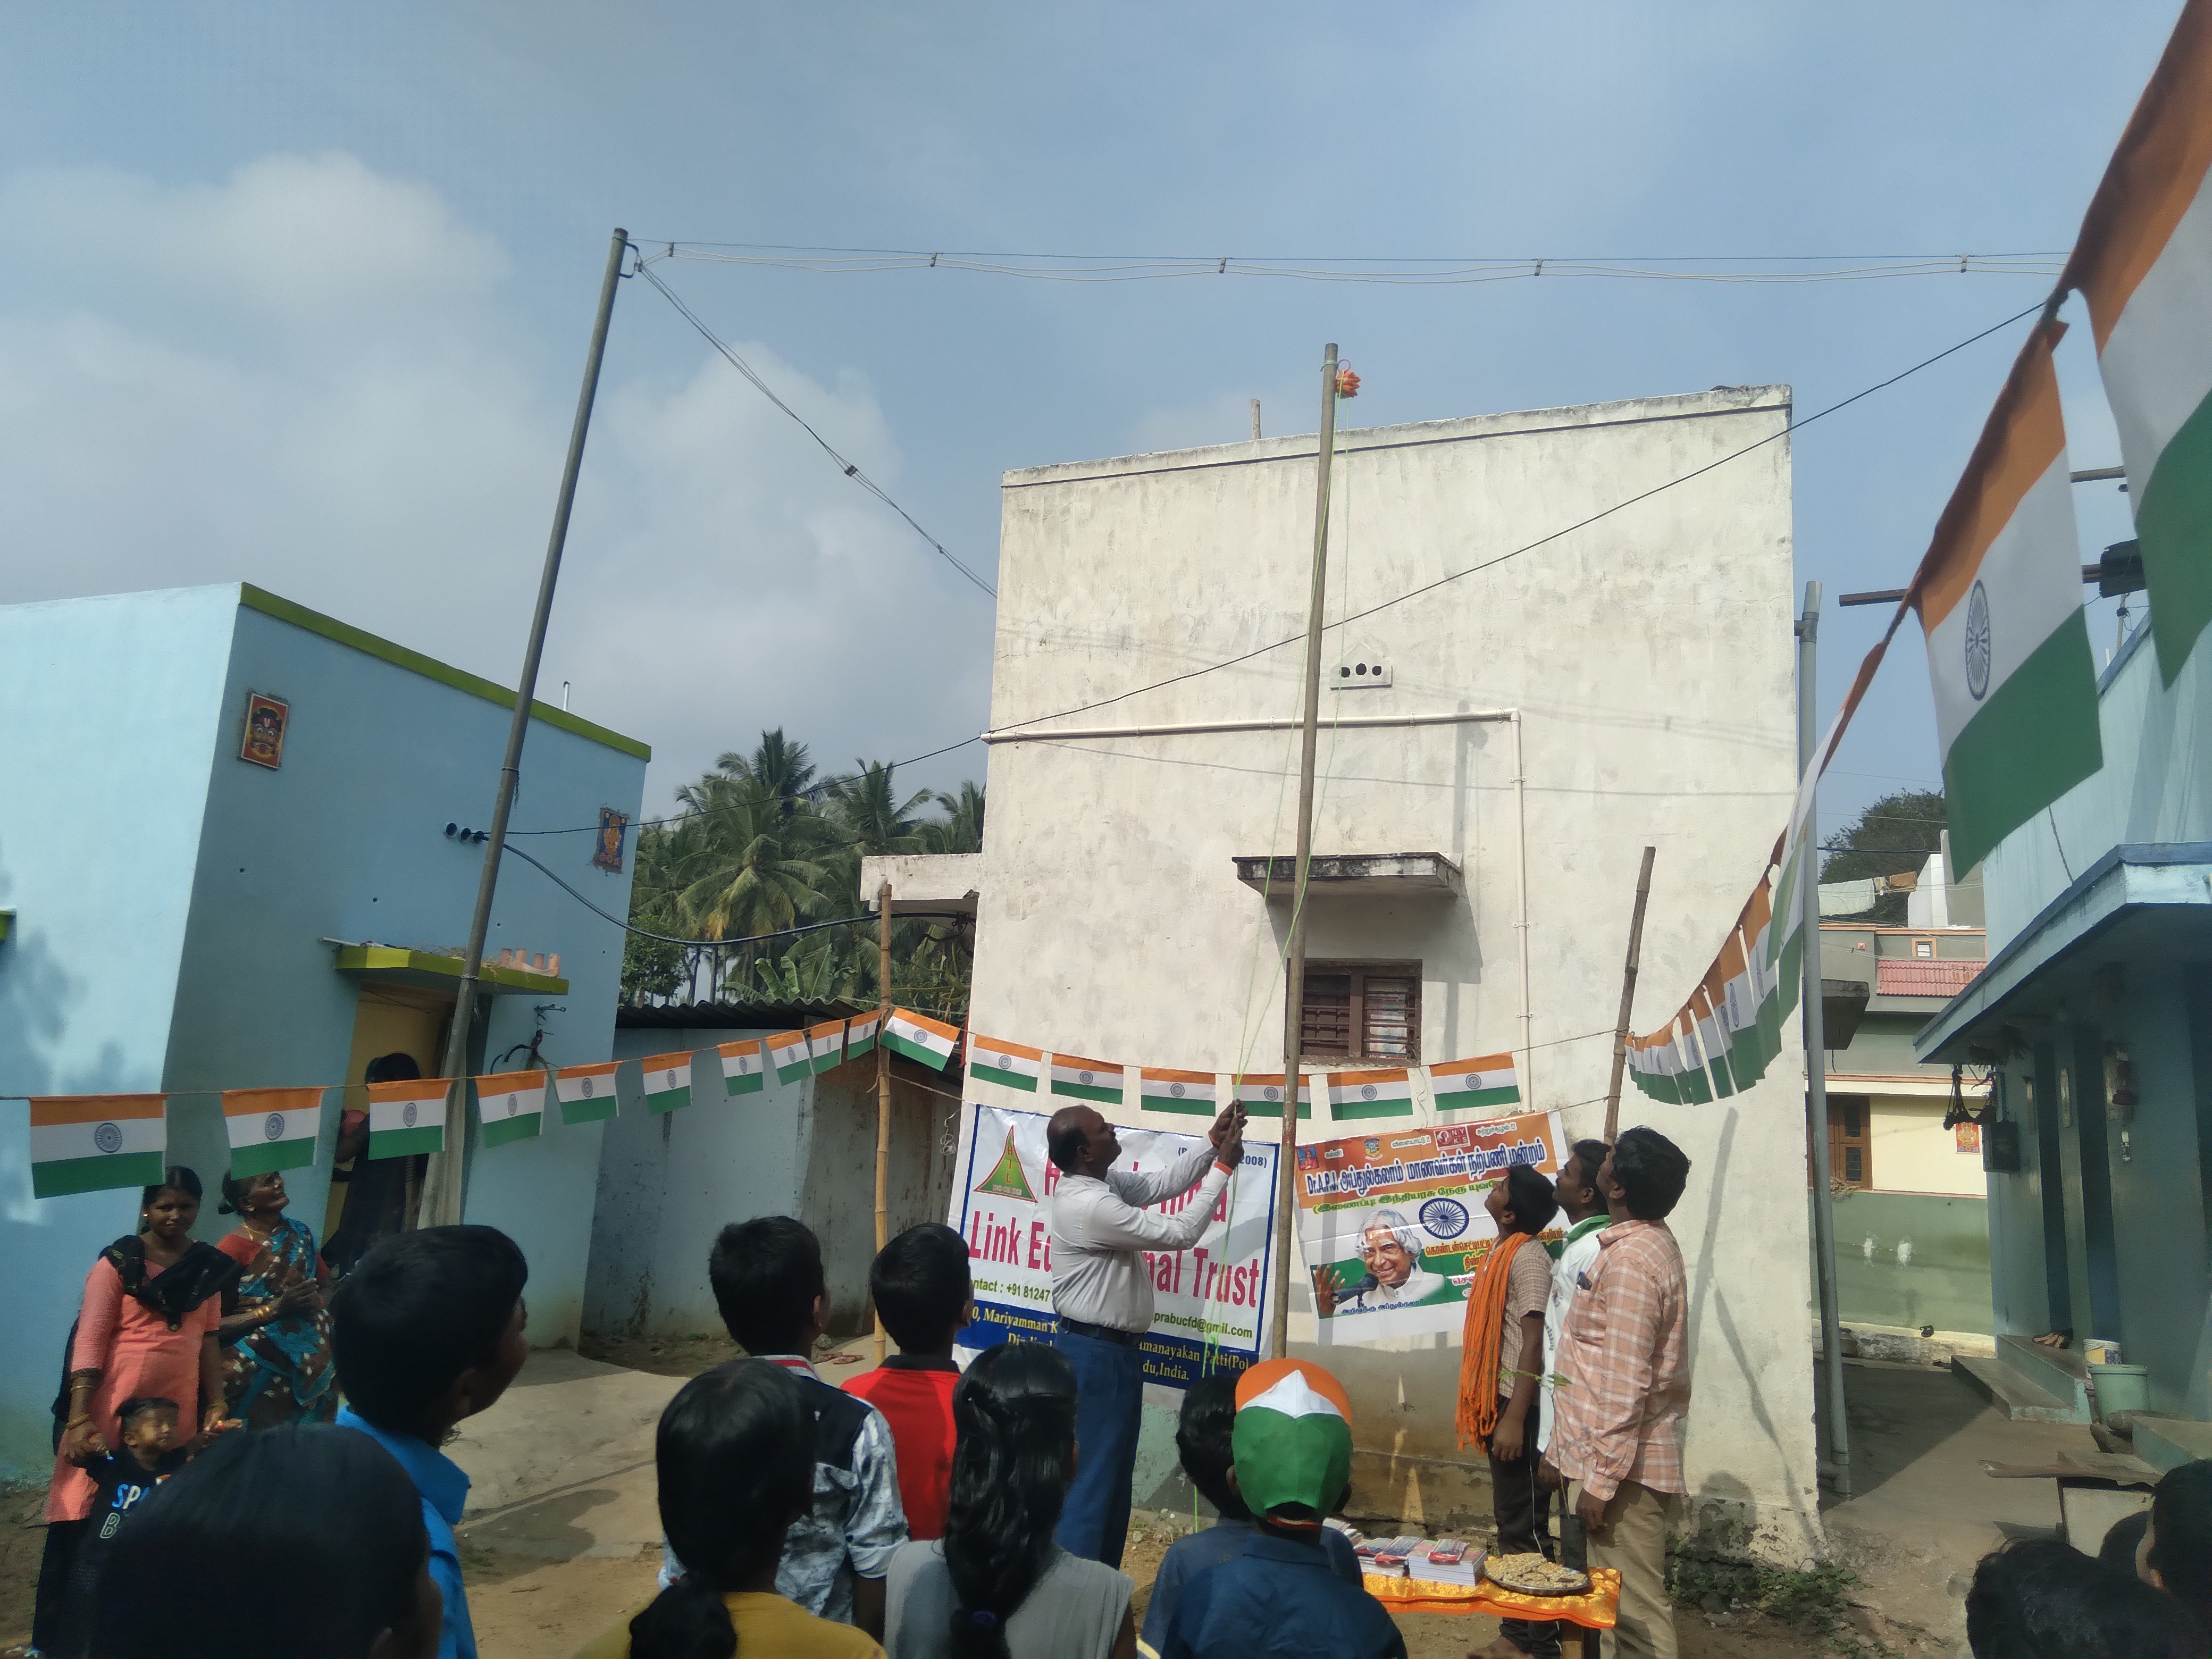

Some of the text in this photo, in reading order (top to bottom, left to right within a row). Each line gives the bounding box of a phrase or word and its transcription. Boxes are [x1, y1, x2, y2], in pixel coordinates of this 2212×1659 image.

[1406, 1150, 1466, 1180] மாணவர்கள்
[1468, 1144, 1507, 1175] நற்பணி
[1438, 1186, 1466, 1196] நேரு
[969, 1211, 1021, 1266] Link
[1193, 1247, 1259, 1308] Trust
[973, 1278, 998, 1293] ntact
[983, 1308, 1048, 1333] Mariyamman
